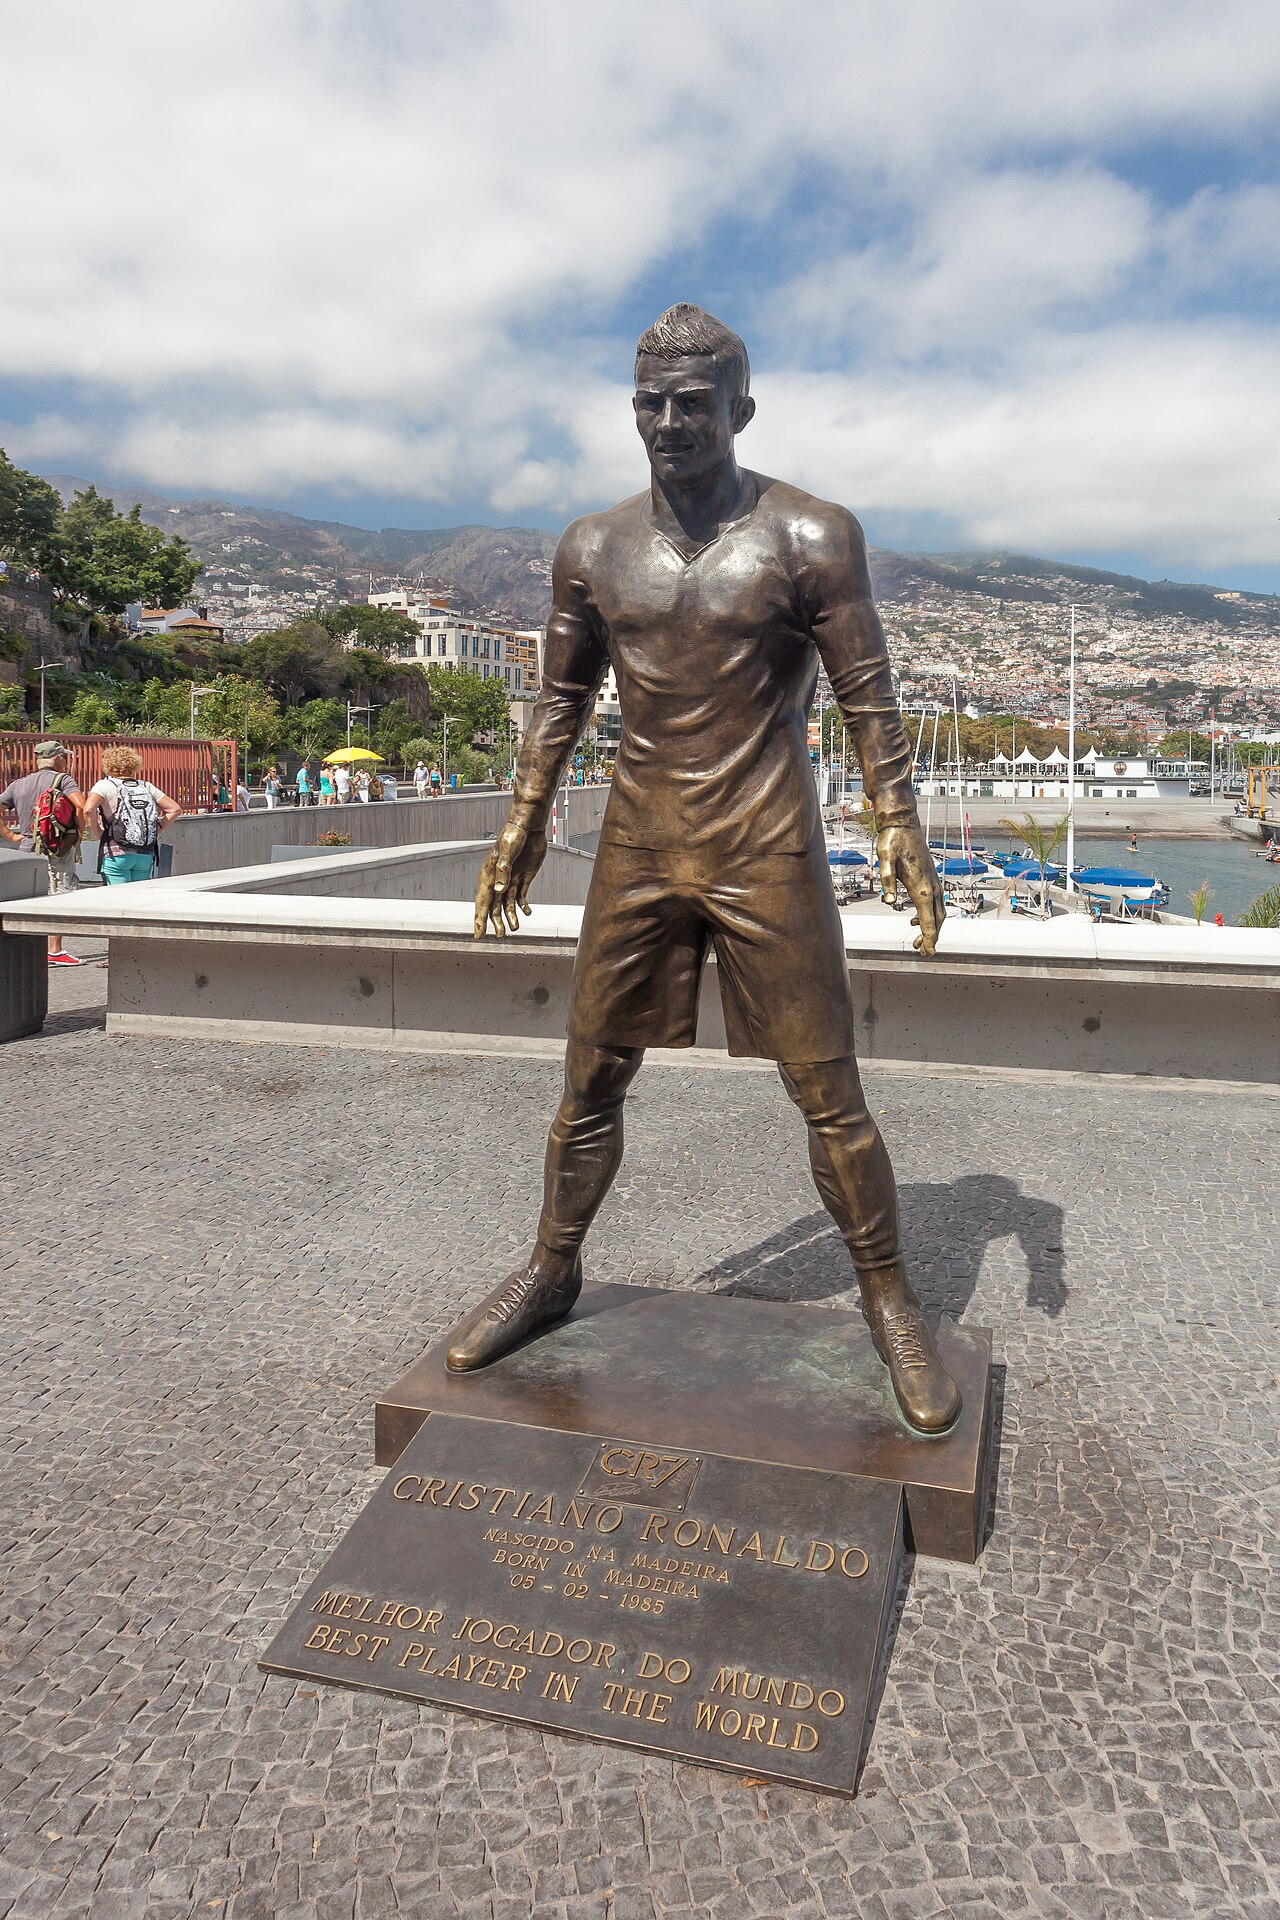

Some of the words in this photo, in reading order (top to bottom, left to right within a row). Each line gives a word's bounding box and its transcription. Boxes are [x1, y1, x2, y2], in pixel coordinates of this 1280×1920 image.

[600, 1447, 689, 1488] CR7
[392, 1474, 624, 1533] CRISTIANO
[639, 1513, 870, 1578] RONALDO
[482, 1527, 575, 1554] NASCIDO
[586, 1546, 616, 1563] NA
[630, 1553, 731, 1584] MADEIRA
[492, 1549, 550, 1572] BORN
[562, 1561, 589, 1578] IN
[603, 1569, 700, 1600] MADEIRA
[510, 1573, 536, 1590] 05
[563, 1582, 590, 1600] 02
[619, 1592, 666, 1615] 1985
[310, 1590, 444, 1635] MELHOR
[637, 1651, 691, 1684] DO
[709, 1665, 846, 1716] MUNDO
[304, 1624, 390, 1662] BEST
[398, 1642, 528, 1692] PLAYER
[540, 1671, 581, 1704] IN
[602, 1682, 674, 1724] THE
[695, 1702, 820, 1752] WORLD
